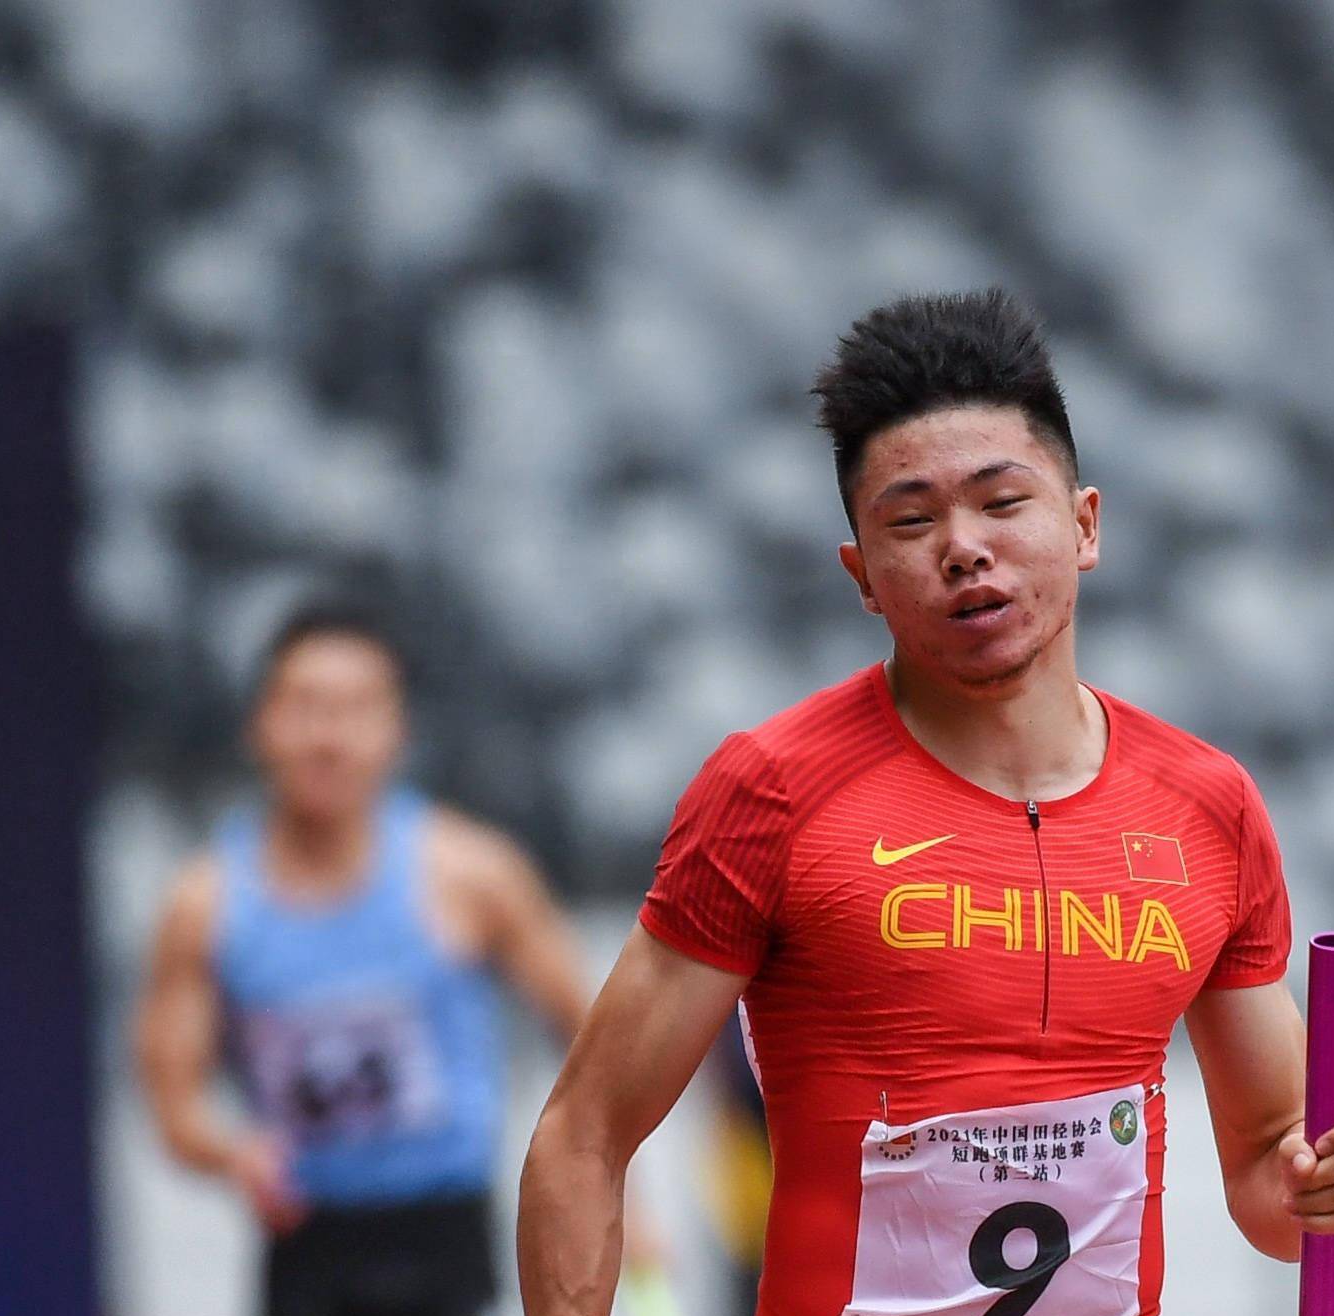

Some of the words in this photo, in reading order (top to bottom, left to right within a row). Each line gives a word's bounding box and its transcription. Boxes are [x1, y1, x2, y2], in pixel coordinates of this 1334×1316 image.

[879, 883, 1192, 973] CHINA
[927, 1116, 1103, 1144] 2021年中国田径协会
[952, 1140, 1086, 1164] 短跑项群基地赛
